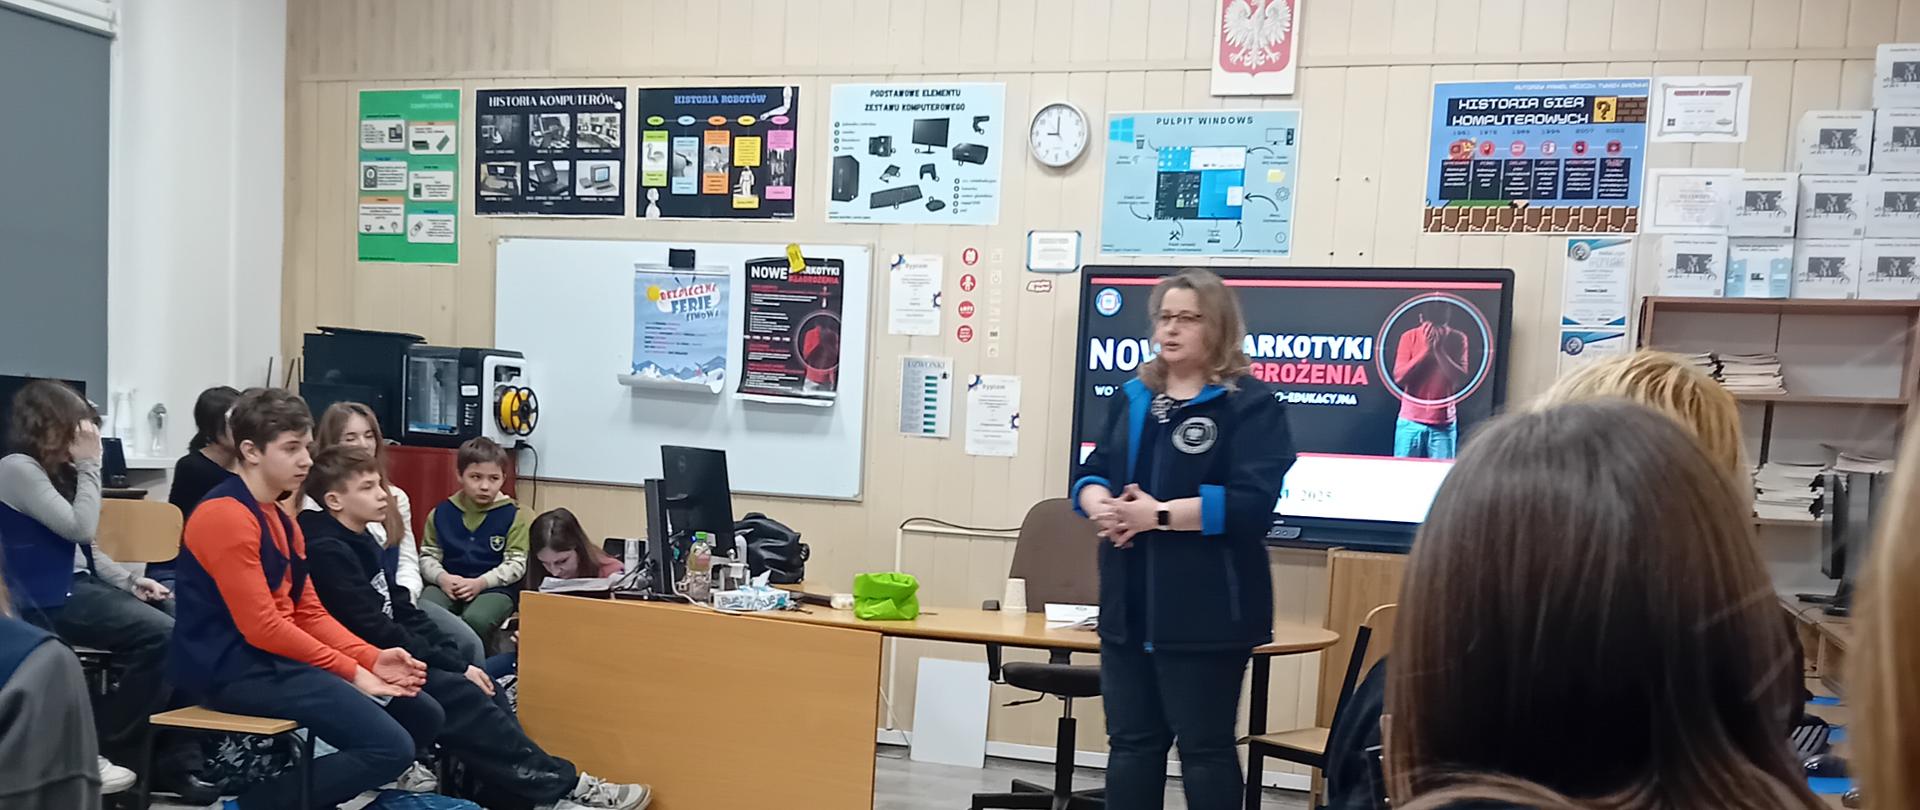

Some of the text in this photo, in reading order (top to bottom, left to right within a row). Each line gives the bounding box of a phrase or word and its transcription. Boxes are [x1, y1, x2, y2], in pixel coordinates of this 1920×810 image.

[489, 92, 615, 108] HISTORIA KOMPUTERÓW
[674, 92, 767, 105] HISTORIA ROBOTÓW
[870, 89, 920, 98] PODSTAWOWE
[865, 103, 965, 112] ZESTAWU KOMPUTEROWEGO
[1458, 96, 1585, 110] HISTORIA GIER
[1156, 115, 1254, 126] PULPIT WINDOWS
[1452, 113, 1589, 126] KOMPUTEROWYCH
[751, 266, 788, 280] NOWE
[671, 295, 711, 314] FERIE
[1242, 333, 1373, 360] ARKOTYKI
[1250, 358, 1369, 385] GROŻENIA
